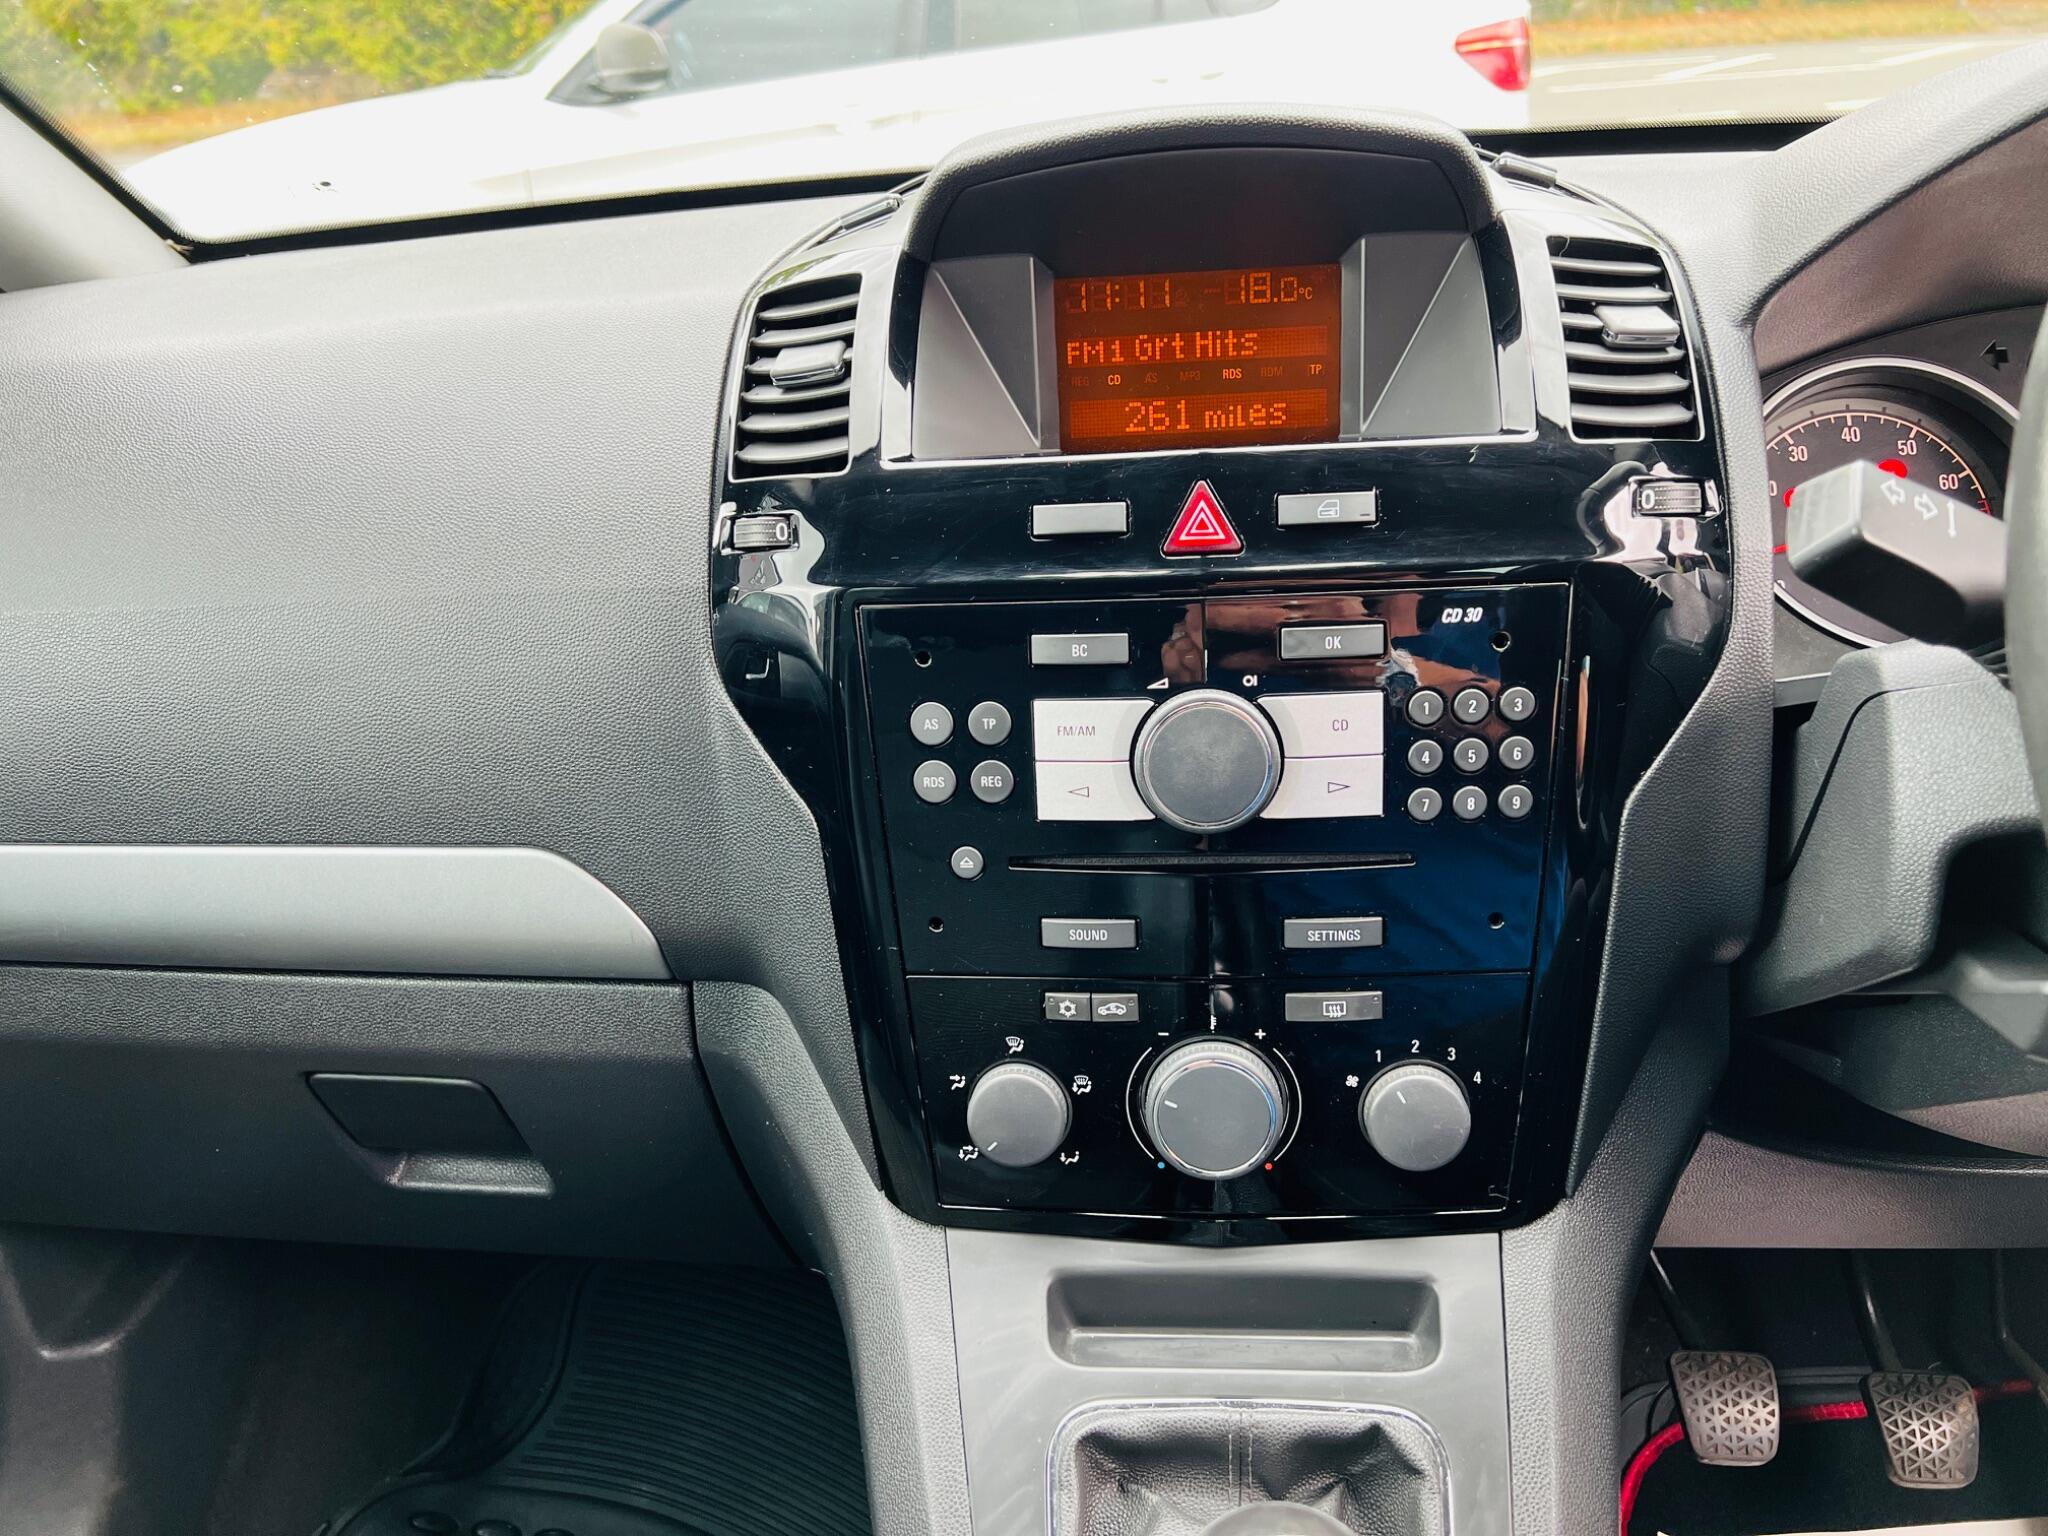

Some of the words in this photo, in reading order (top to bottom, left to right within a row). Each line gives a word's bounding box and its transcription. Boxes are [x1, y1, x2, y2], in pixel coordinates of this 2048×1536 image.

[1080, 278, 1171, 312] 11:11
[1067, 339, 1125, 365] FM1
[1135, 332, 1185, 361] Grt
[1195, 329, 1259, 358] Hits
[1107, 374, 1121, 385] CD
[1222, 368, 1243, 380] RDS
[1310, 364, 1323, 375] TP
[1125, 400, 1190, 433] 261
[1204, 402, 1287, 429] miles
[1841, 427, 1861, 442] 40
[1788, 445, 1808, 462] 30
[1897, 440, 1917, 455] 50
[1938, 474, 1959, 490] 60
[1441, 608, 1463, 623] CD
[1463, 607, 1483, 622] 30
[1325, 636, 1341, 650] OK
[1071, 644, 1088, 657] BC
[1423, 702, 1430, 715] 1
[1468, 700, 1476, 713] 2
[1514, 698, 1522, 711] 3
[924, 719, 938, 730] AS
[982, 718, 996, 730] TP
[1332, 719, 1349, 732] CD
[1057, 725, 1096, 737] FM/AM
[1421, 751, 1430, 764] 4
[1467, 749, 1476, 763] 5
[1513, 747, 1521, 760] 6
[923, 776, 945, 788] RDS
[980, 776, 1002, 787] REG
[1422, 798, 1430, 812] 7
[1467, 797, 1475, 810] 8
[1512, 796, 1520, 809] 9
[1069, 929, 1108, 941] SOUND
[1307, 929, 1361, 942] SETTINGS
[1411, 1039, 1420, 1053] 2
[1375, 1049, 1382, 1062] 1
[1447, 1047, 1456, 1061] 3
[1473, 1071, 1482, 1084] 4
